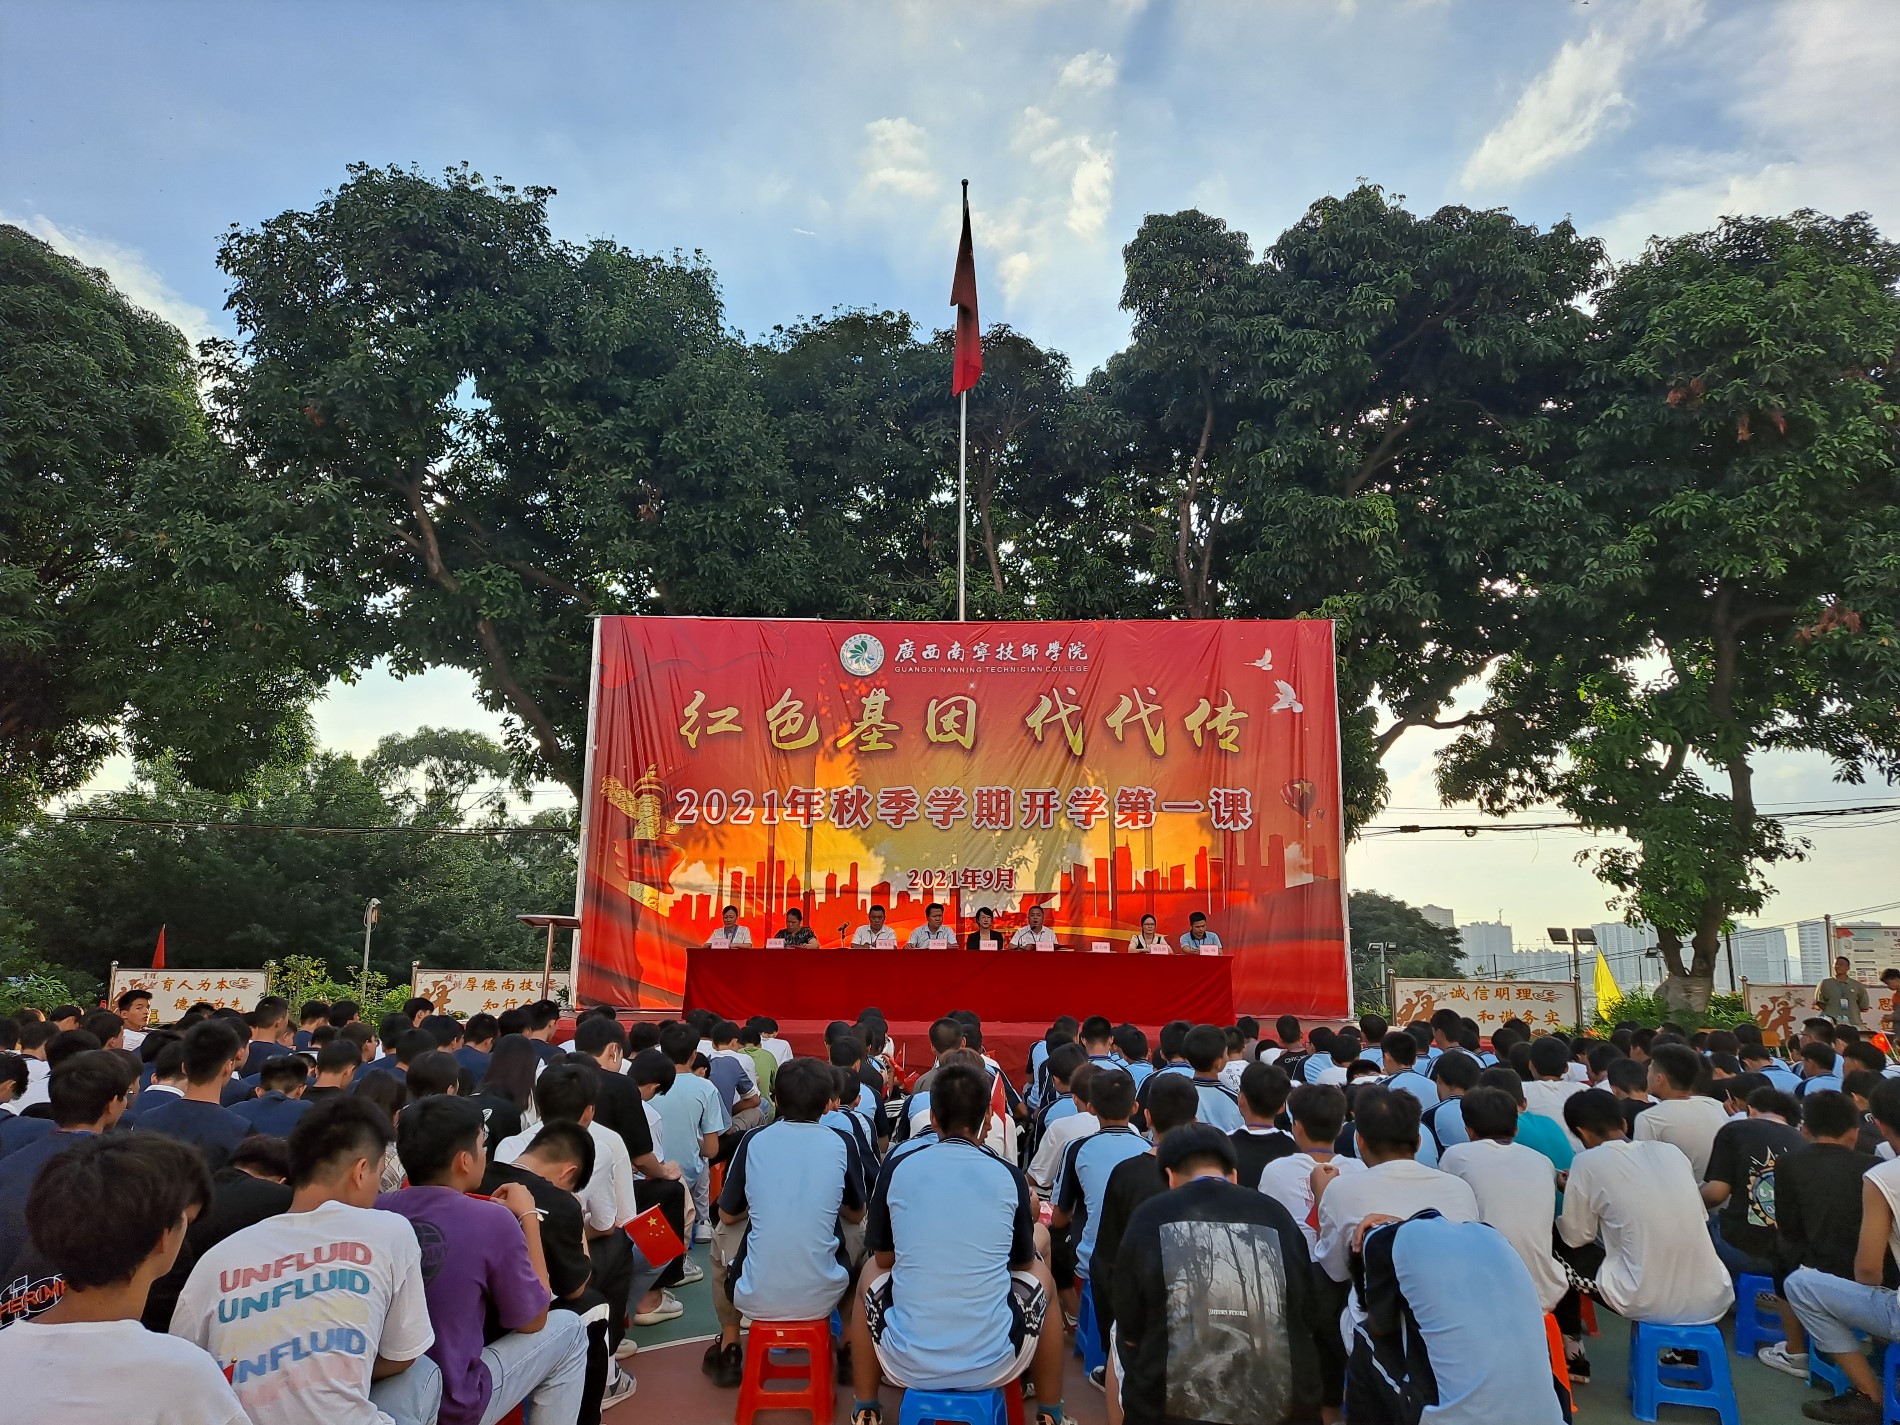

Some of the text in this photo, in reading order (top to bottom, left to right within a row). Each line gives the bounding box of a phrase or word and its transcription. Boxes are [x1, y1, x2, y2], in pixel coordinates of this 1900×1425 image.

[1045, 665, 1089, 673] COLLEGE
[679, 687, 1249, 756] 红色基因 代代传
[674, 786, 1253, 831] 2021年秋季学期开学第一课
[907, 867, 1015, 891] 2021年9月
[161, 977, 231, 992] 育人为本
[462, 977, 536, 992] 厚德尚技
[1449, 985, 1533, 1001] 诚信明理
[220, 1241, 372, 1293] UNFLUID
[218, 1269, 370, 1323] UNFLUID
